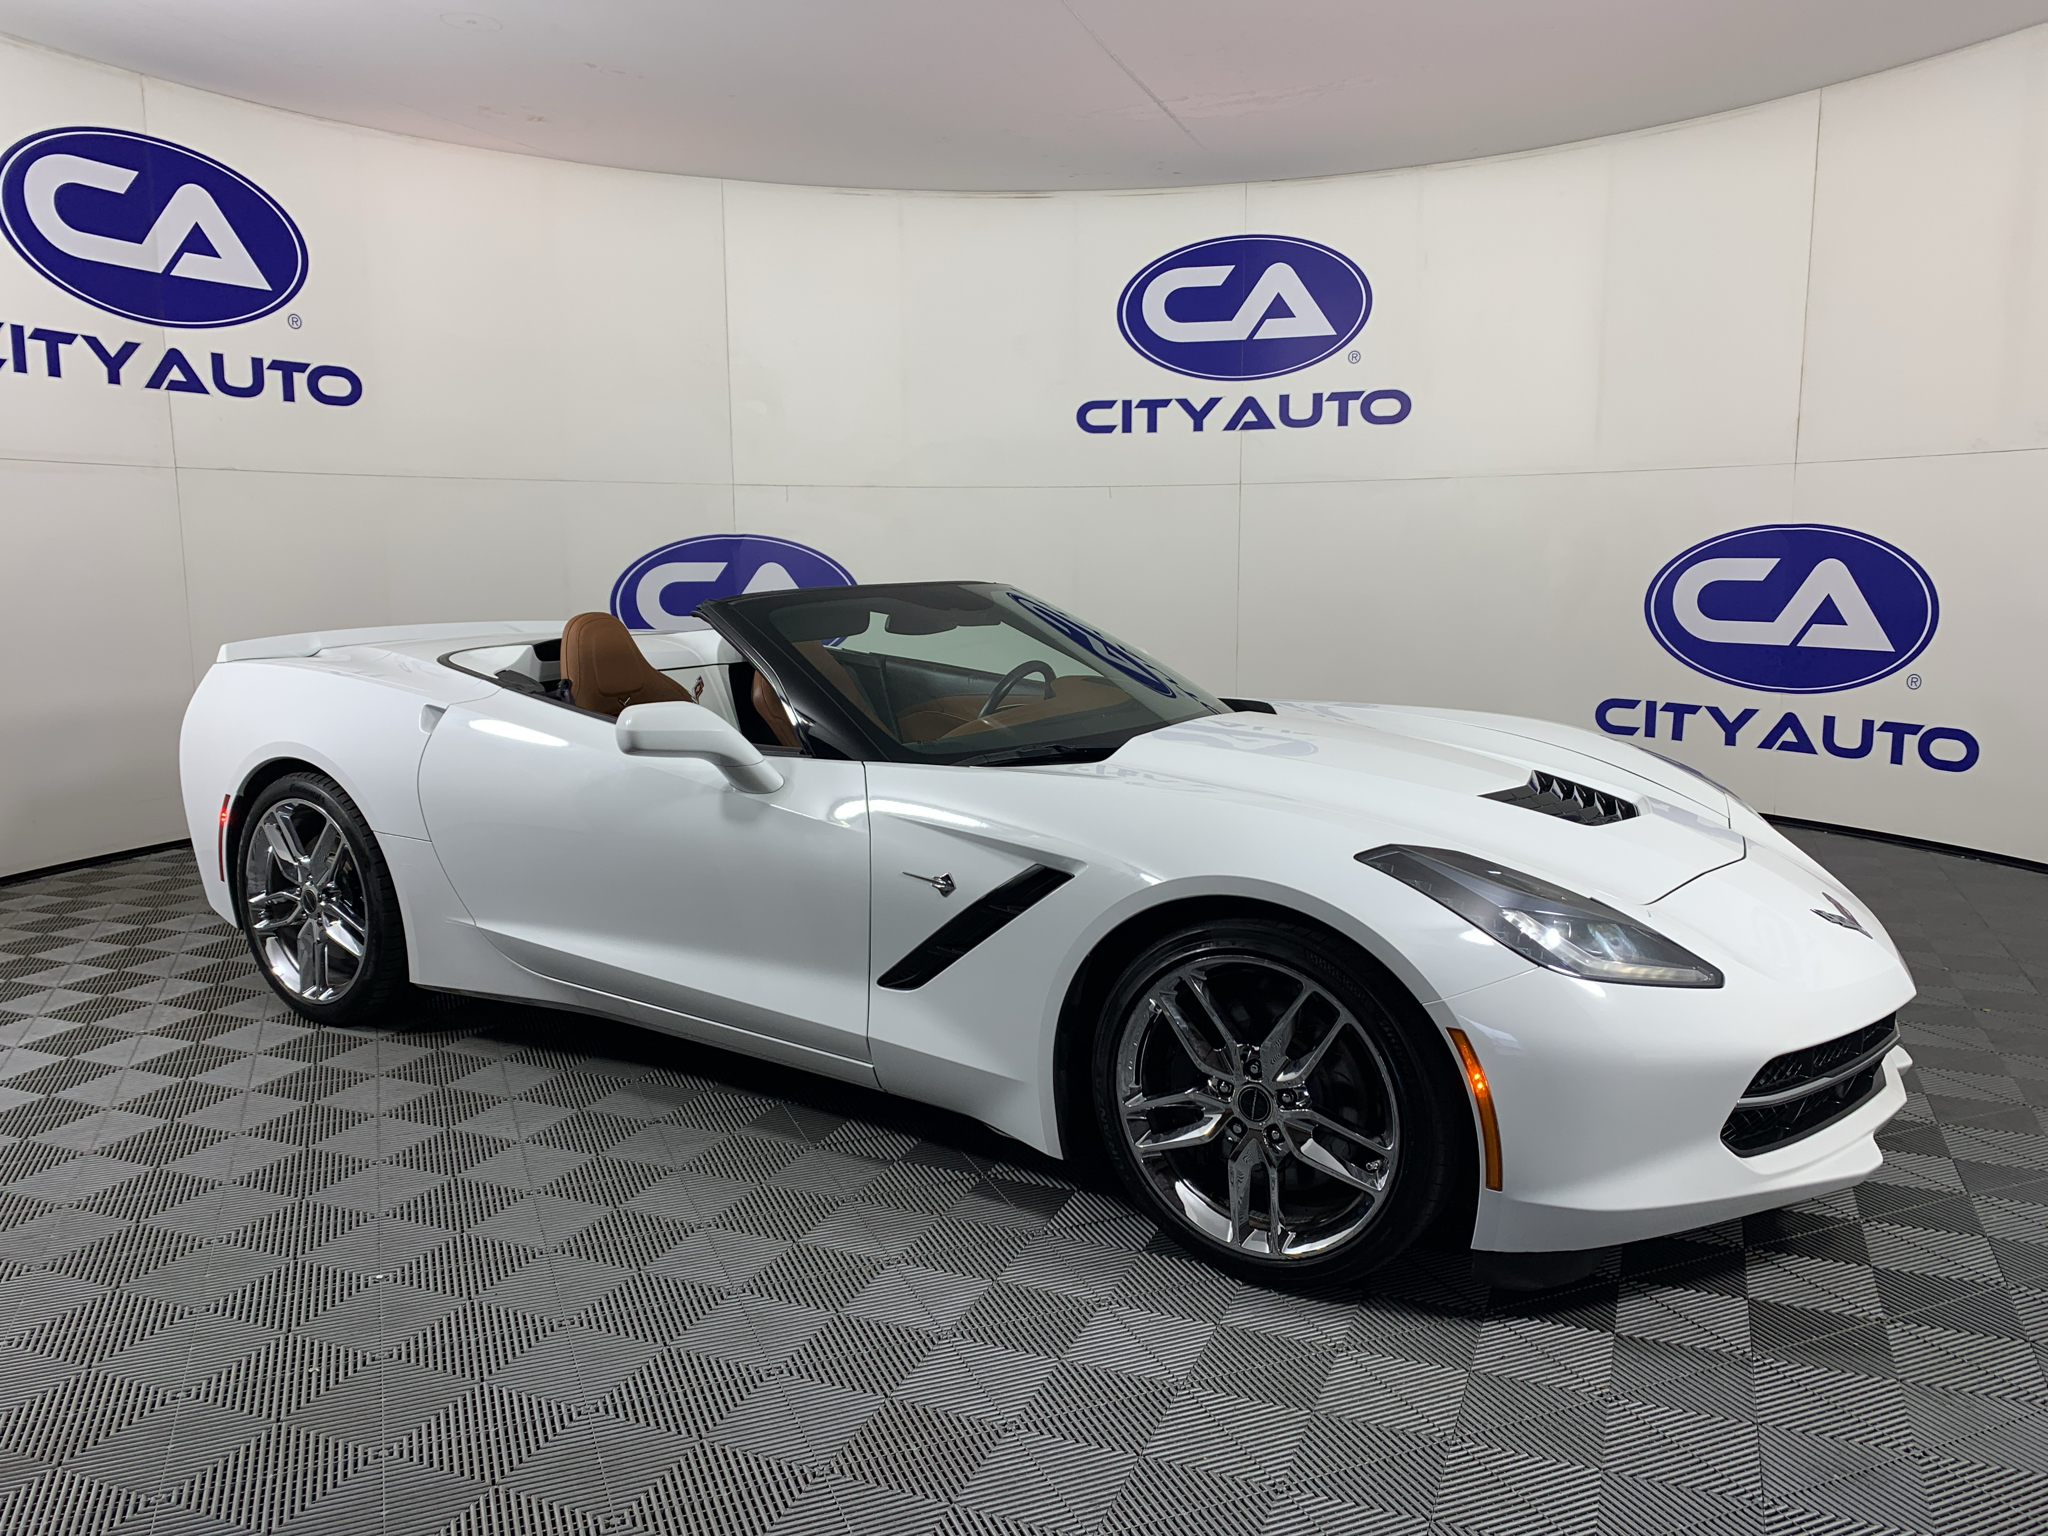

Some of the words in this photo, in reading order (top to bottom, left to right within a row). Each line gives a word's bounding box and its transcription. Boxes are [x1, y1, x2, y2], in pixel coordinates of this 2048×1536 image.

[24, 153, 273, 291] CA
[1141, 261, 1338, 343] CA
[0, 321, 142, 385] ITY
[144, 347, 363, 407] AUTO
[1075, 396, 1223, 434] CITY
[1222, 389, 1412, 432] AUTO
[1672, 557, 1896, 652] CA
[1595, 697, 1760, 747] CITY
[1757, 711, 1980, 773] AUTO
